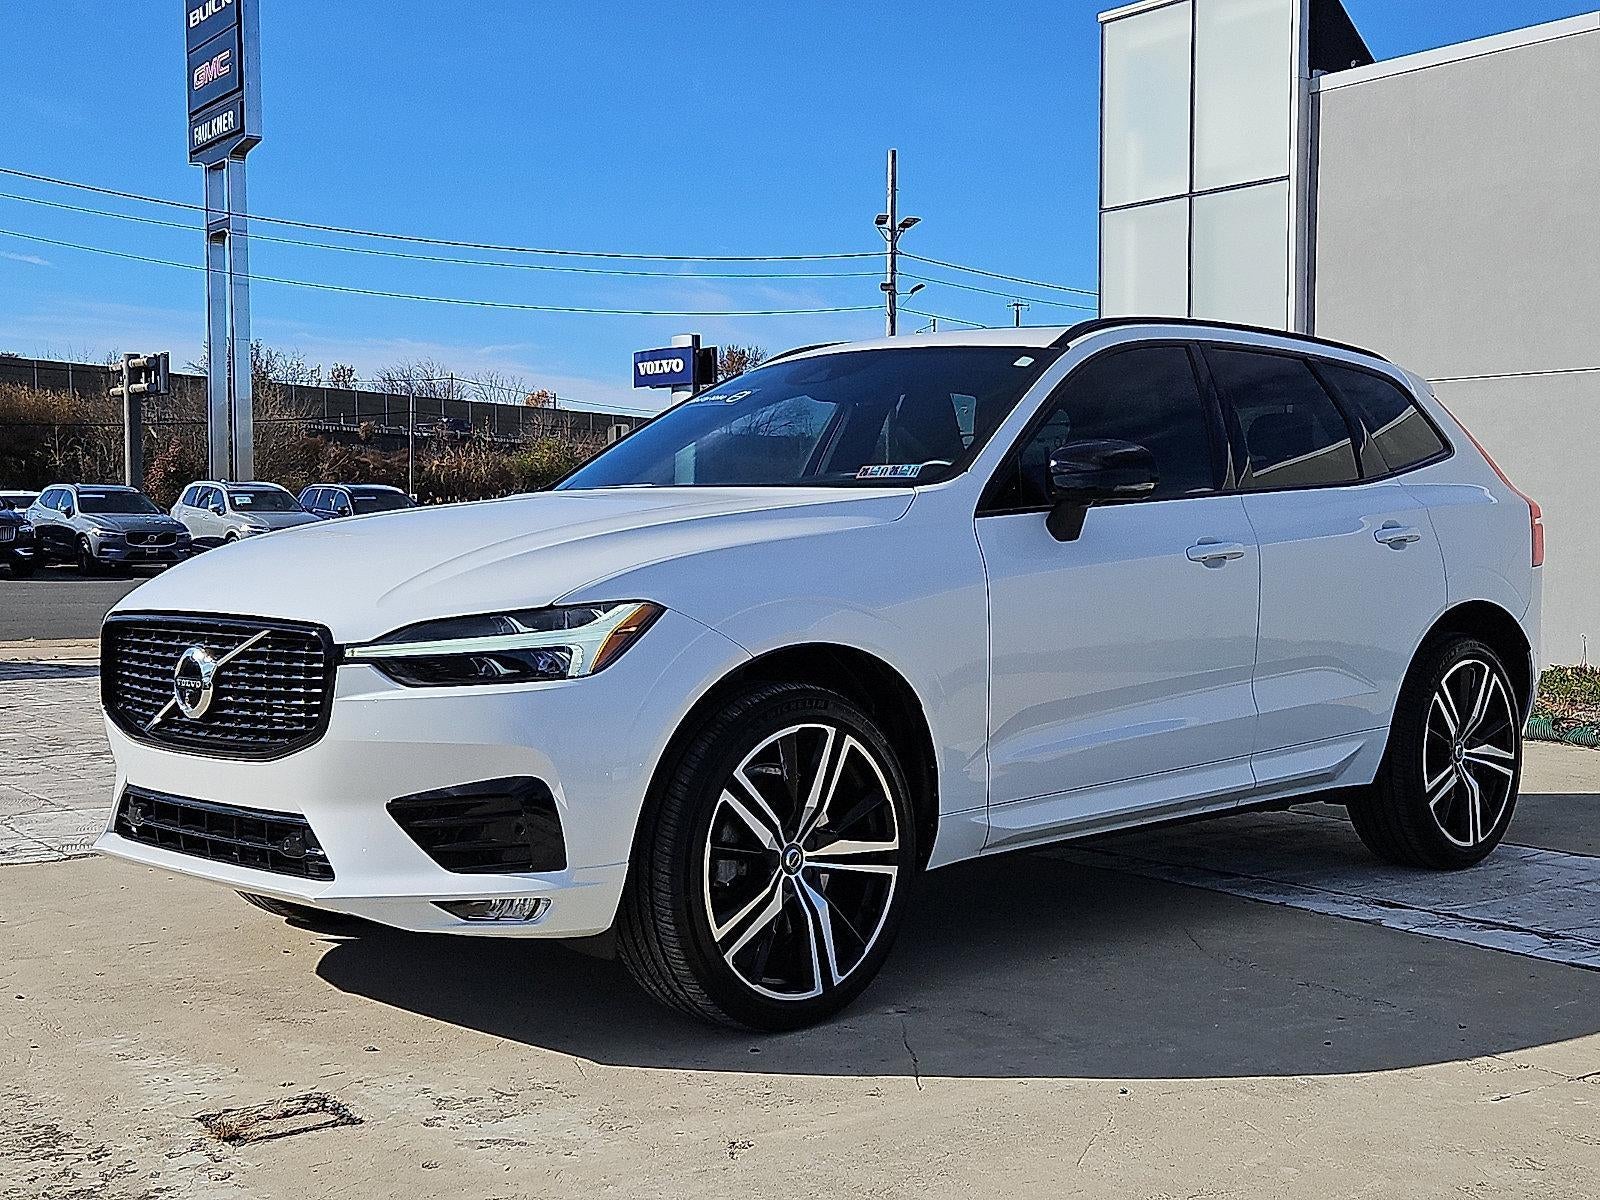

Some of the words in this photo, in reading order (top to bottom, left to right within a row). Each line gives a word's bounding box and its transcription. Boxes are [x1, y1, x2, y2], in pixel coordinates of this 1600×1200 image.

[194, 50, 230, 91] GMC
[193, 110, 235, 146] FAULKNER
[638, 358, 684, 376] VOLVO
[176, 679, 202, 688] VOLVO
